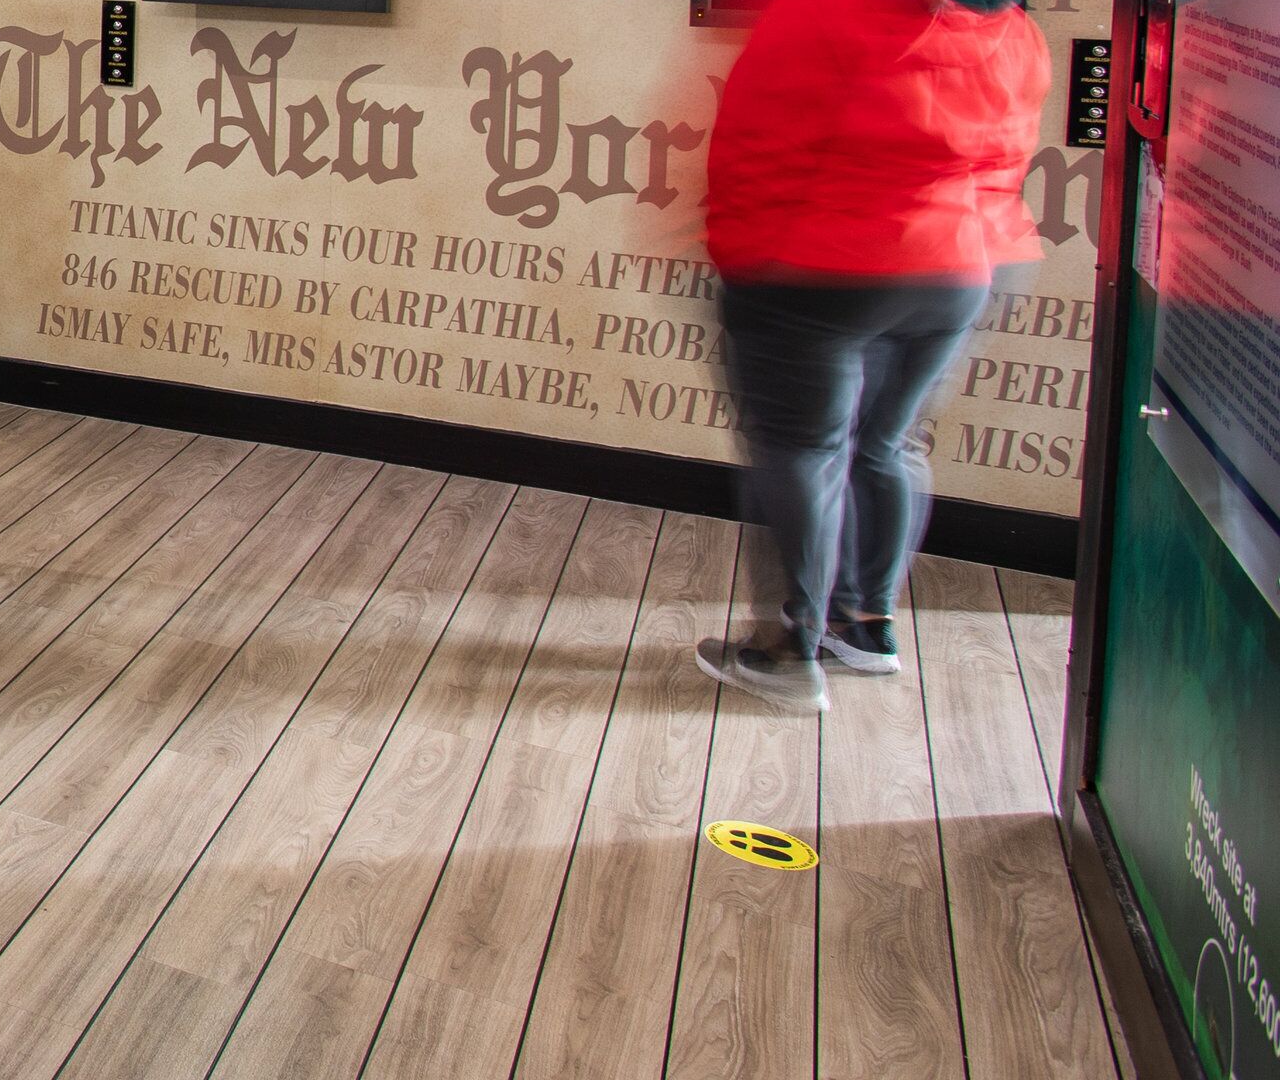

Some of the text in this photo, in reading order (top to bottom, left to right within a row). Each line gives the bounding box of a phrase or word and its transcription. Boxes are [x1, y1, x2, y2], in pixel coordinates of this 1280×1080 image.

[185, 25, 426, 184] New
[462, 45, 724, 231] Yor
[61, 255, 117, 292] 846
[128, 260, 284, 318] RESCUED
[293, 274, 342, 317] BY
[349, 283, 576, 354] CARPATHIA,
[69, 200, 715, 301] TITANIC SINKS FOUR HOURS AFTER
[36, 302, 132, 349] ISMAY
[140, 314, 230, 368] SAFE,
[242, 330, 315, 373] MRS
[322, 339, 442, 391] ASTOR
[458, 355, 601, 419] MAYBE,
[1184, 822, 1237, 954] 3,840mtrs
[1190, 763, 1256, 926] Wreck site at
